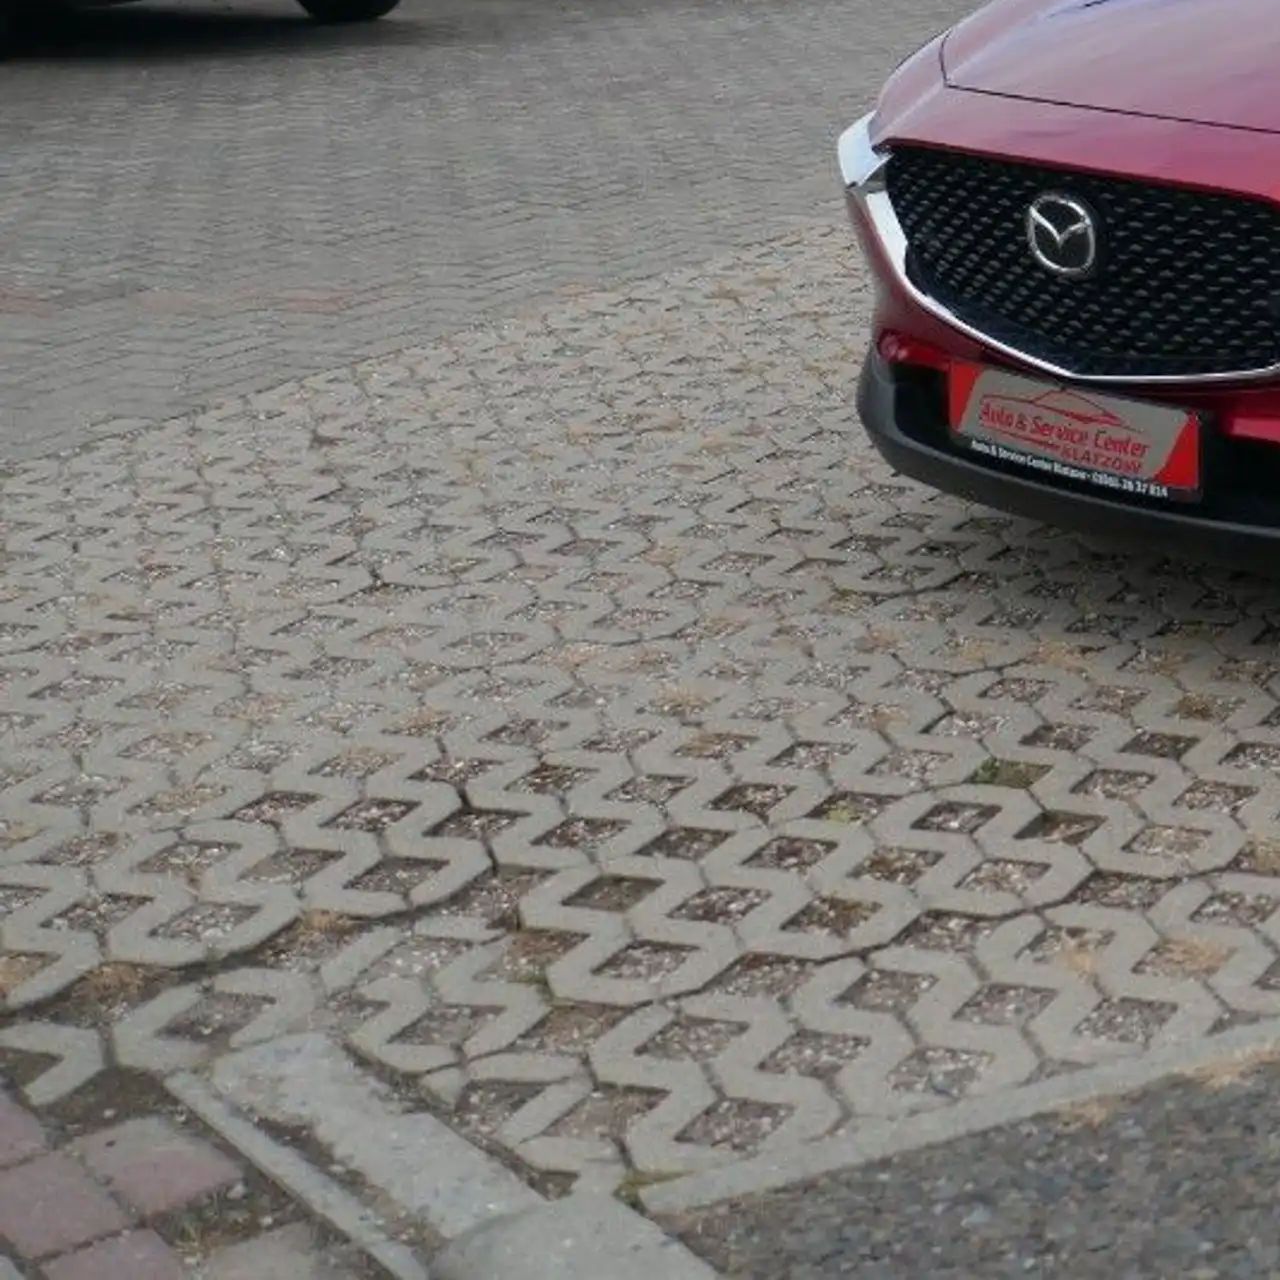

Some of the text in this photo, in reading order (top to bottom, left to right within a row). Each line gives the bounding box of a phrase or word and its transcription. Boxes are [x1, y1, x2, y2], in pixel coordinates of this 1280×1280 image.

[981, 402, 1151, 458] Auto & Service Center
[1060, 446, 1142, 475] KLATZOW
